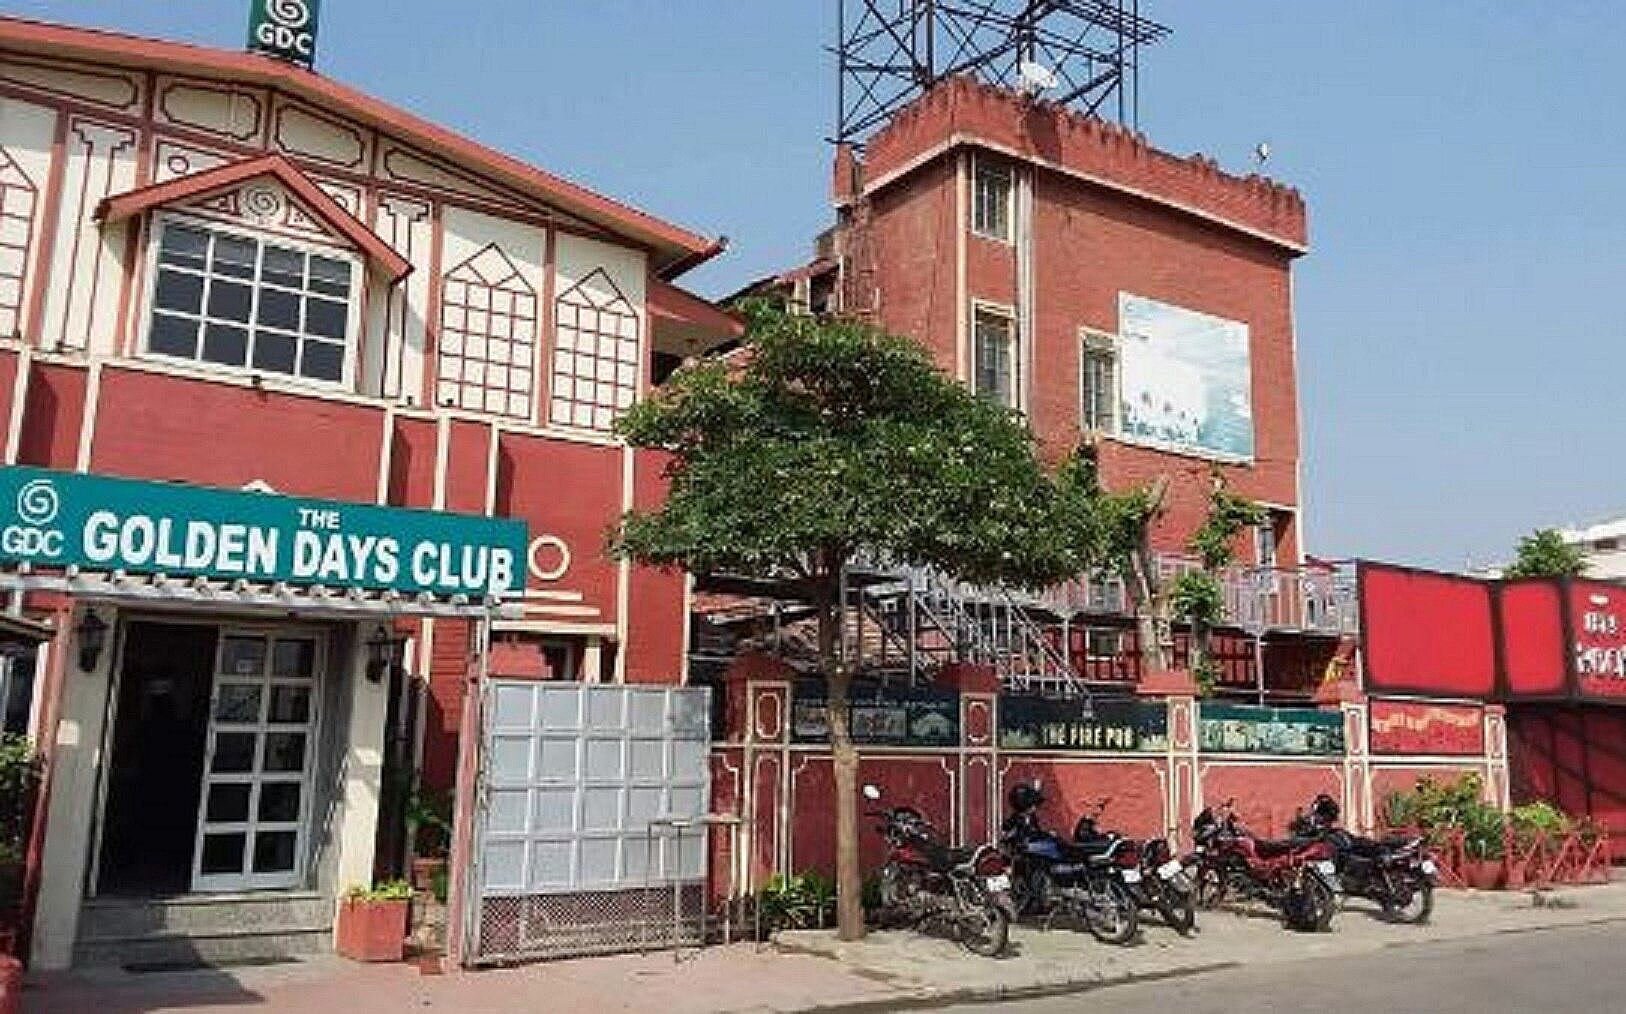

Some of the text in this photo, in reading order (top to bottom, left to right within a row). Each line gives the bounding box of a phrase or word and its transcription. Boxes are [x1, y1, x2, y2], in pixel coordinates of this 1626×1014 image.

[256, 22, 314, 55] GDC
[298, 508, 341, 530] THE
[1, 525, 65, 557] GDC
[82, 510, 514, 592] GOLDEN DAYS CLUB
